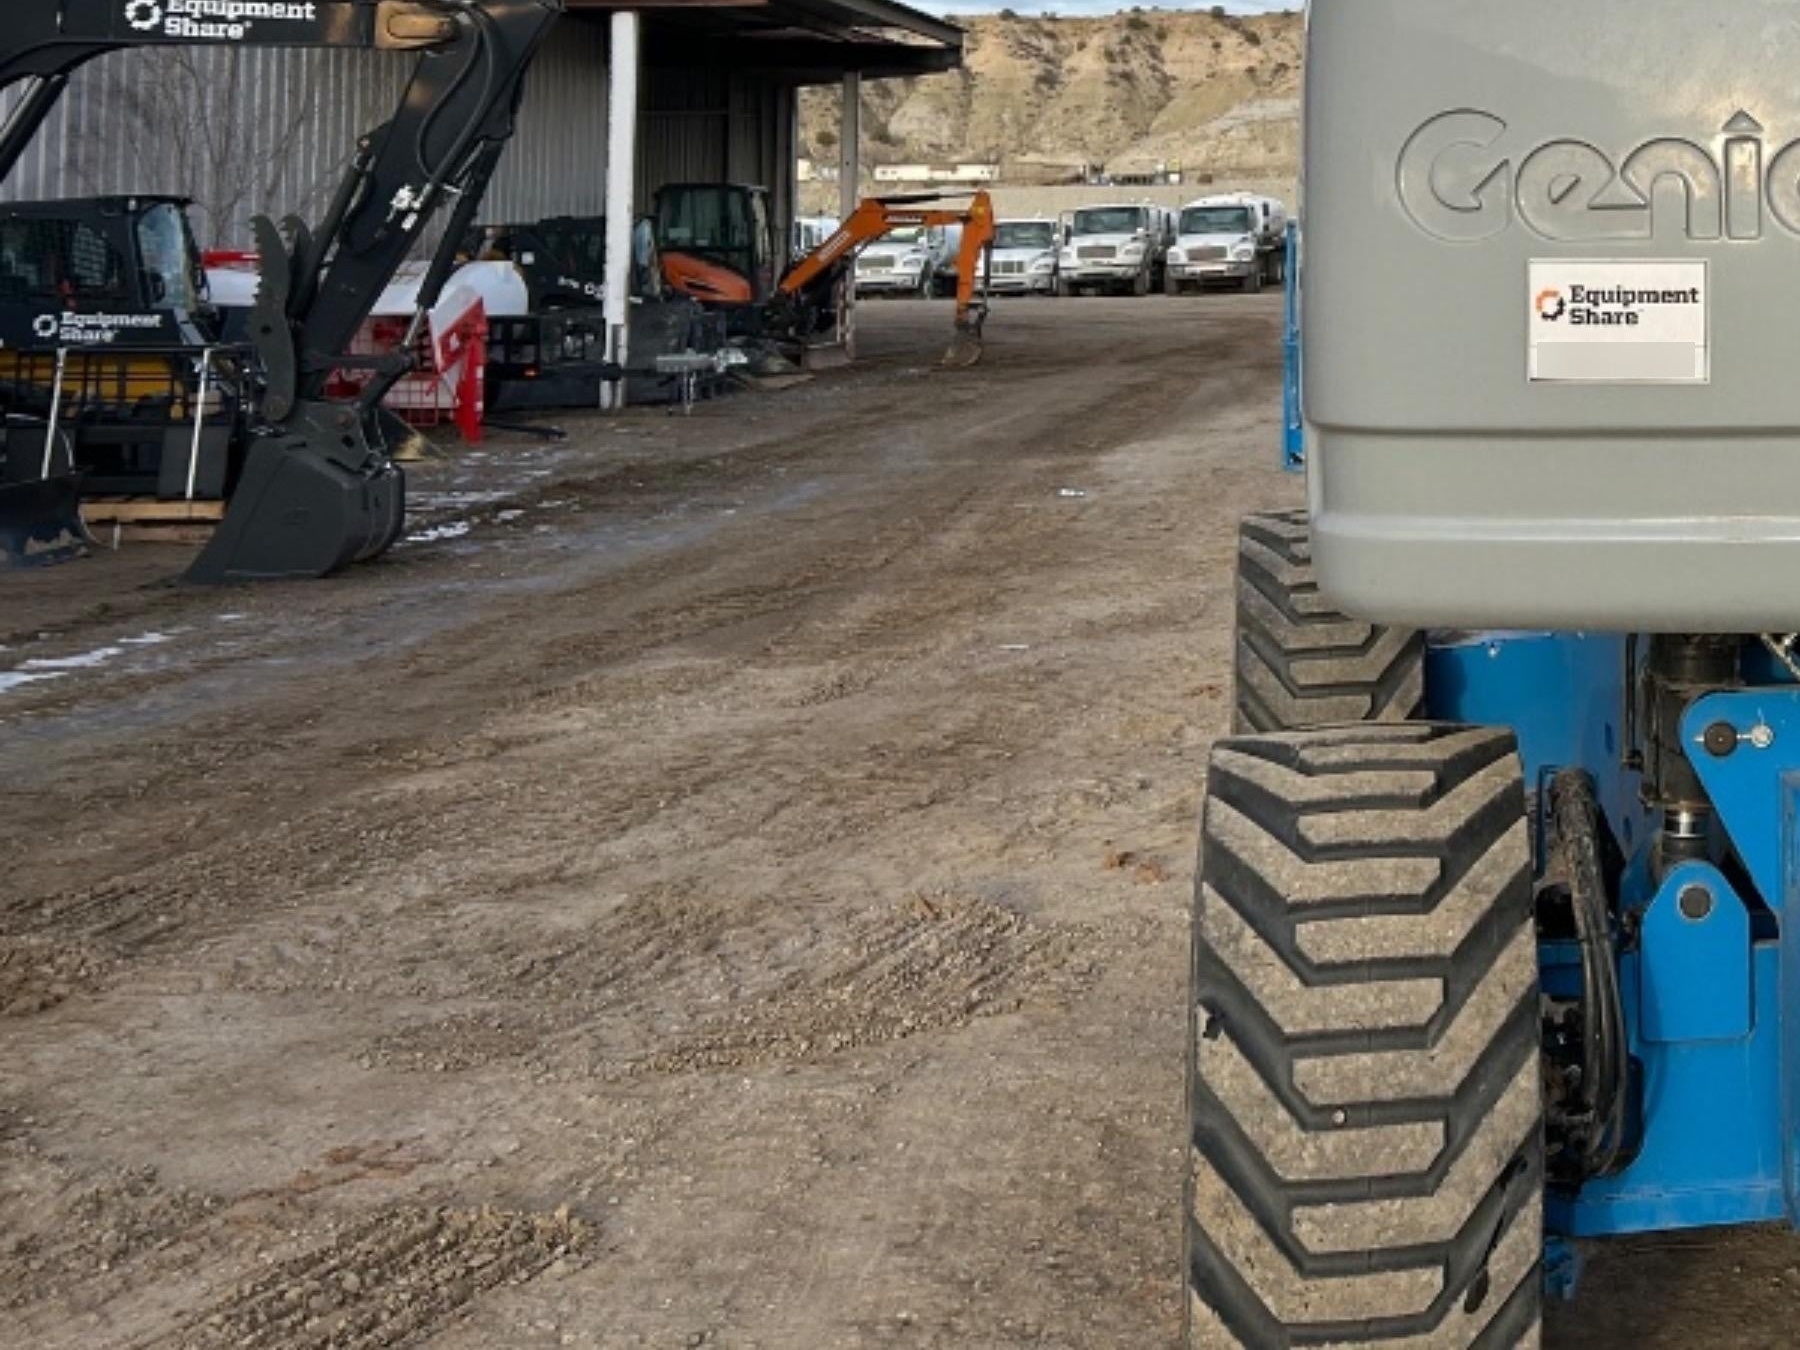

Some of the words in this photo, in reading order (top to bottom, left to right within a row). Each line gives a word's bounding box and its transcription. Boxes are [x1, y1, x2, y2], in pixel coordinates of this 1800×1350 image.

[164, 16, 244, 39] Share
[1569, 284, 1699, 307] Equipment
[61, 311, 163, 328] Equipment
[1569, 308, 1639, 325] Share
[59, 327, 114, 342] Share
